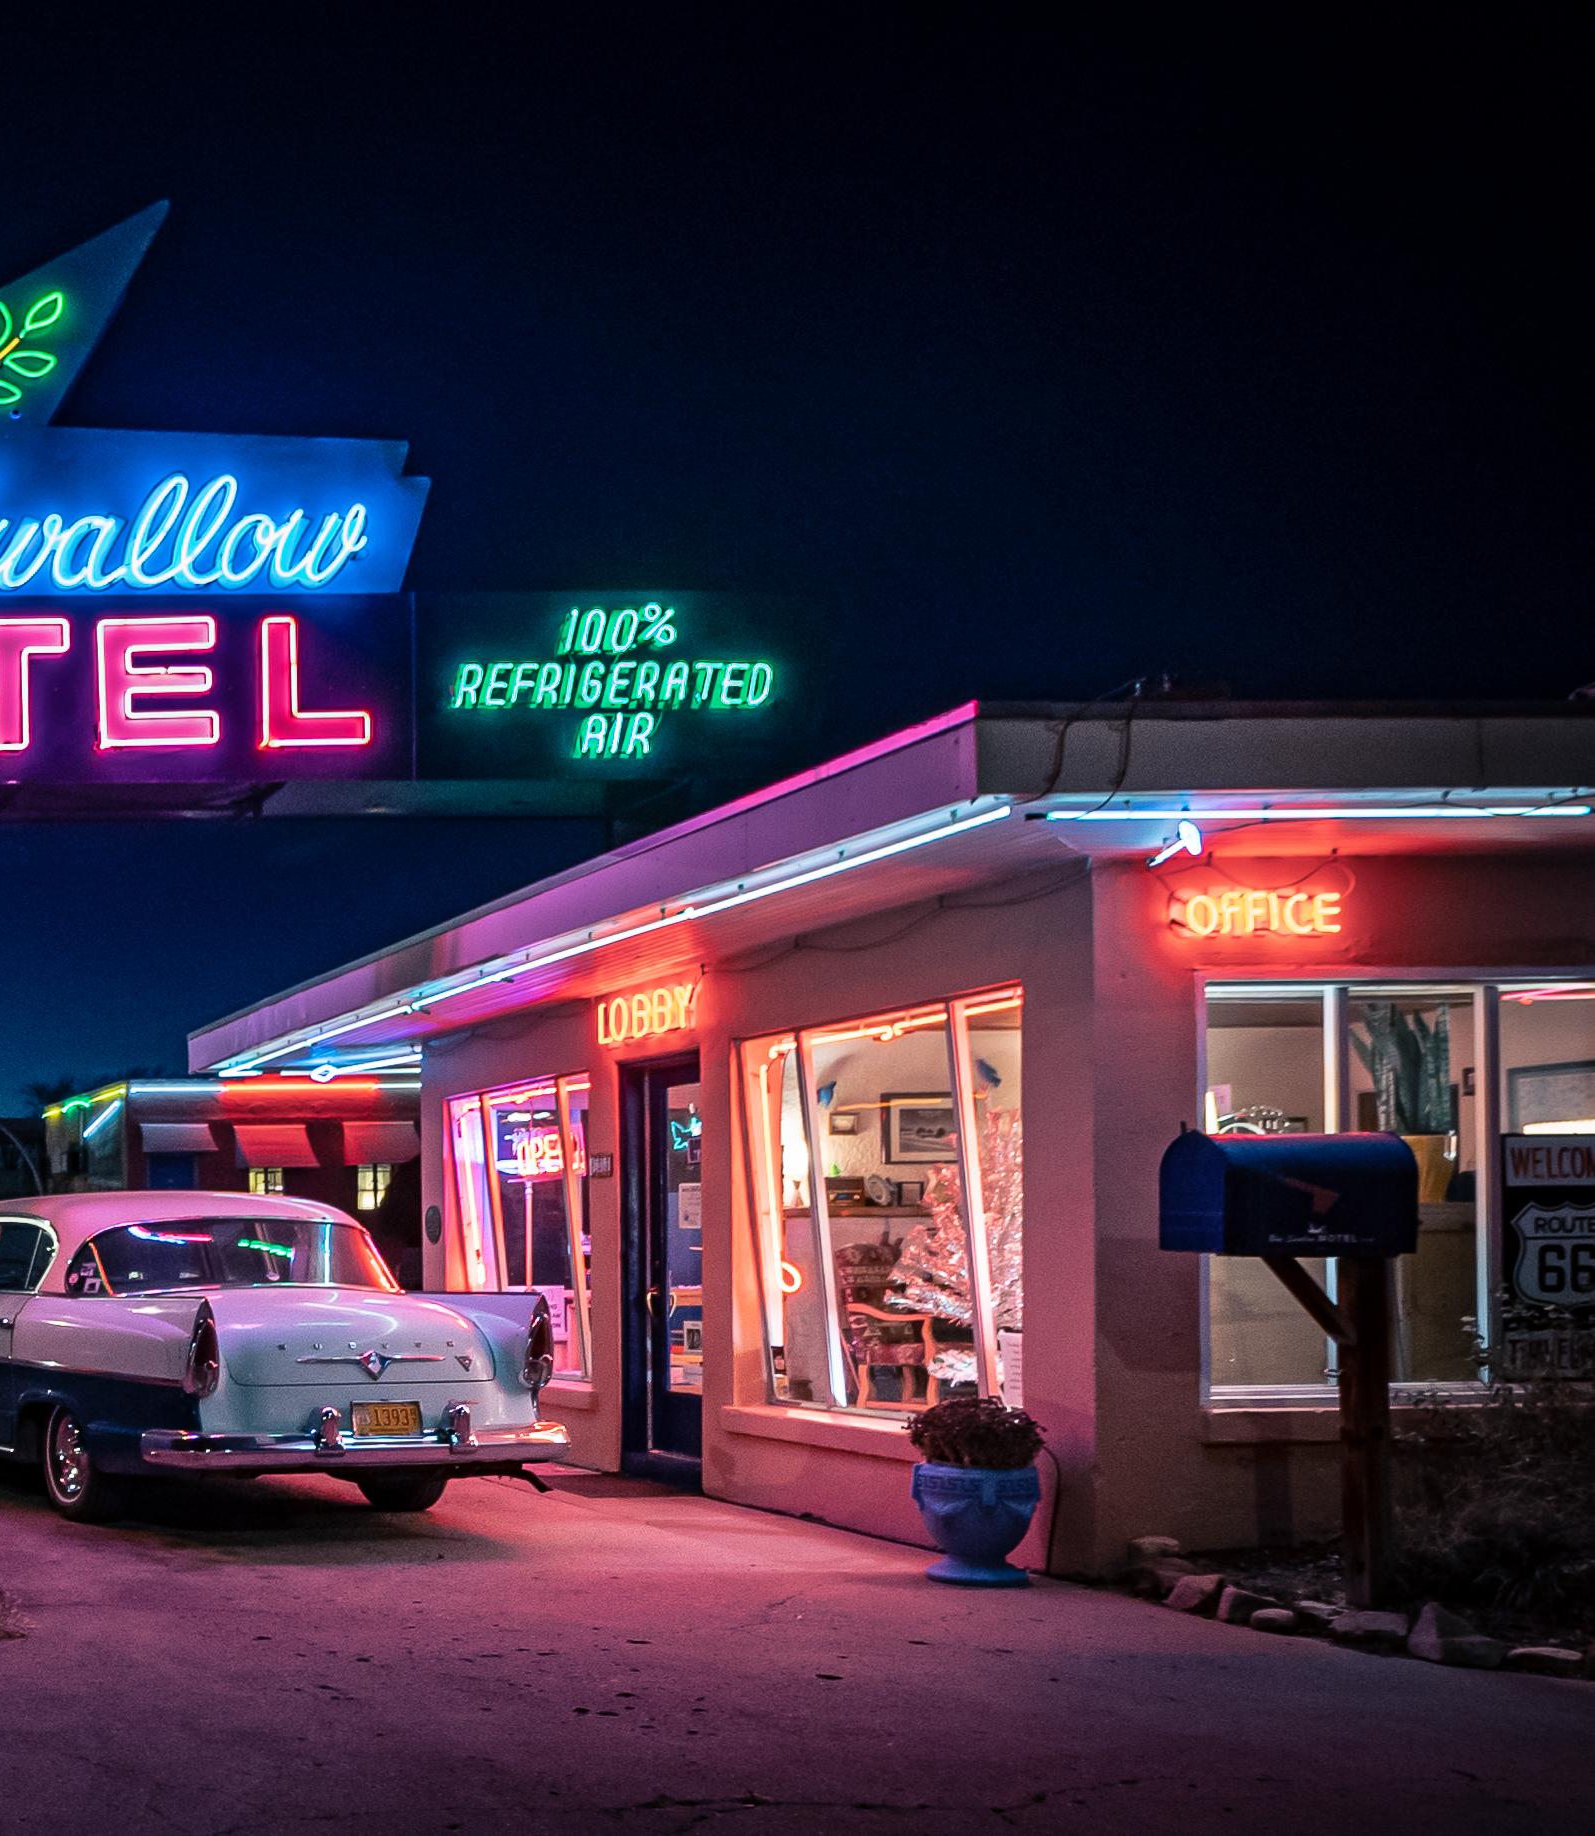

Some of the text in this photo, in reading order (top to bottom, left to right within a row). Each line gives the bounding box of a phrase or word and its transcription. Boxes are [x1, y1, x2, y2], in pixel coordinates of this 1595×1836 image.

[558, 601, 677, 655] 100%
[453, 659, 774, 709] REFRIGERATED
[574, 711, 656, 758] AIR
[1185, 890, 1343, 936] OFFICE
[597, 983, 695, 1045] LOBBY
[1537, 1243, 1595, 1294] 66
